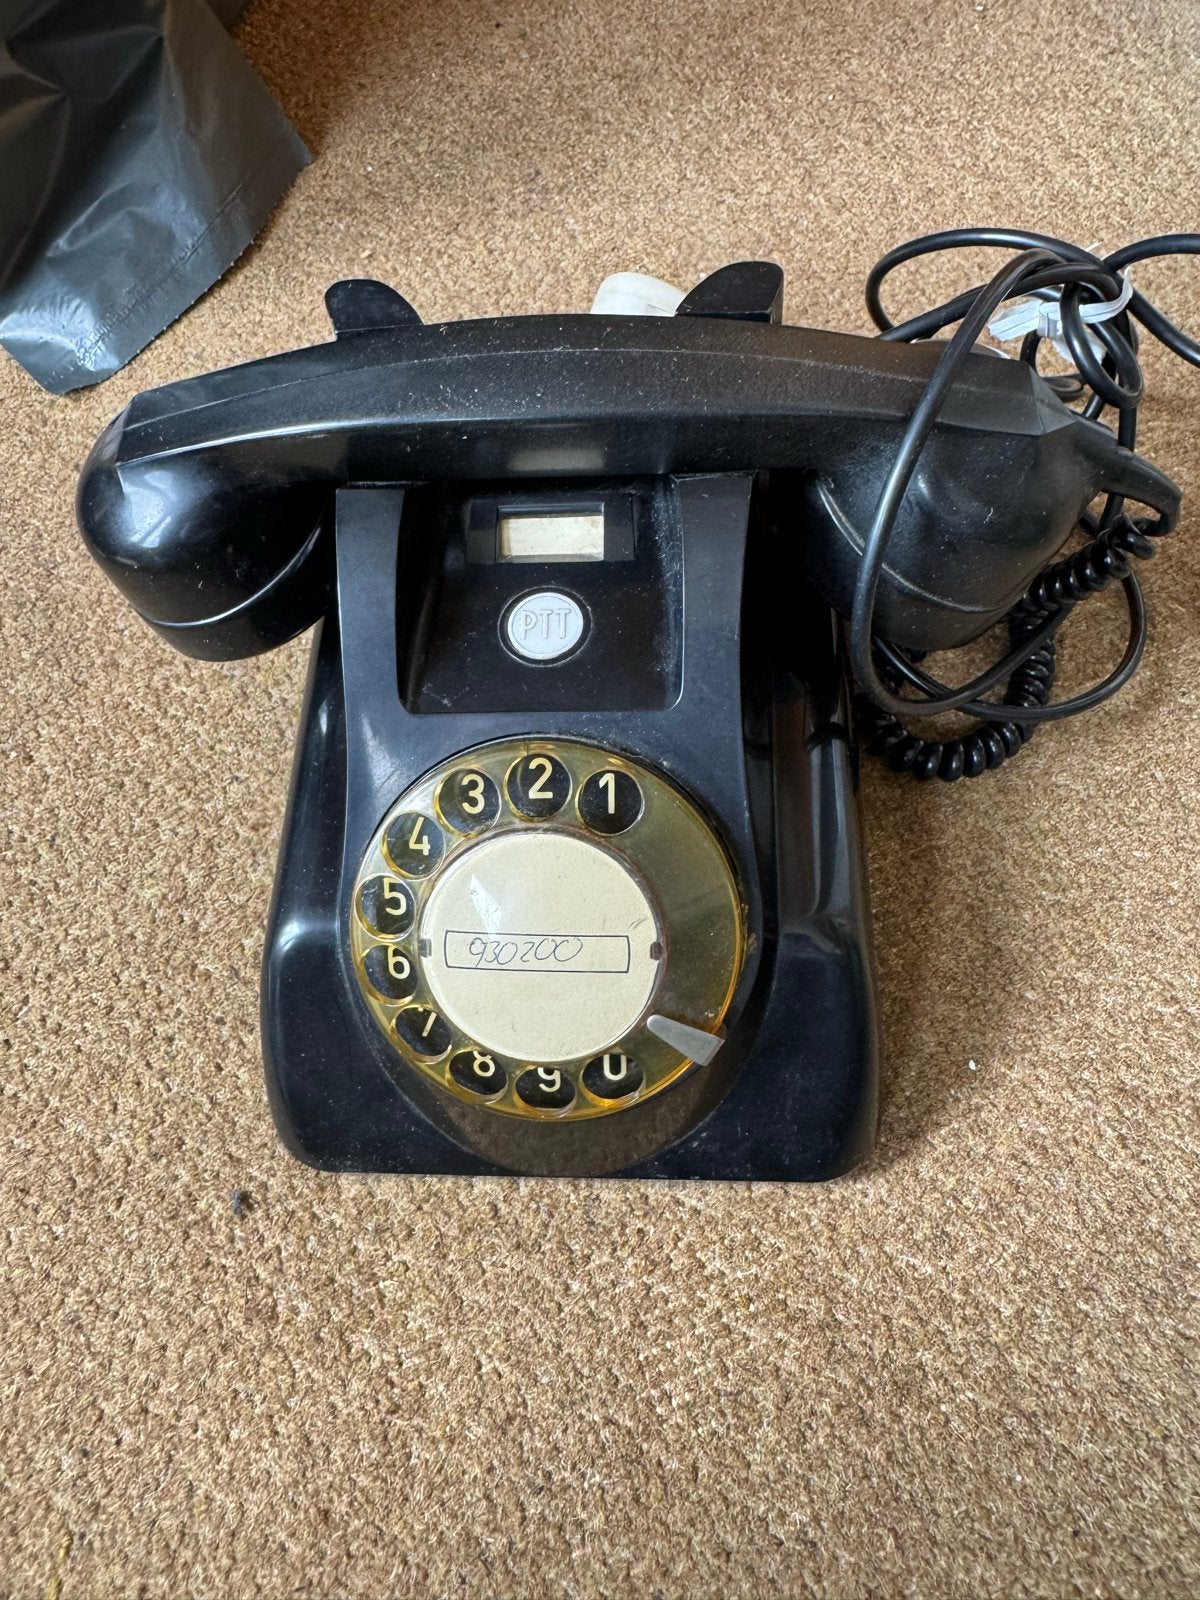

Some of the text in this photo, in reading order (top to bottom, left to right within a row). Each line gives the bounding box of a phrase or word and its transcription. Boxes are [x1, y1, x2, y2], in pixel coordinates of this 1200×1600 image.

[520, 607, 571, 640] PTT
[461, 773, 485, 814] 3
[528, 757, 554, 799] 2
[598, 773, 616, 814] 1
[408, 816, 431, 856] 4
[383, 877, 407, 916] 5
[387, 945, 411, 979] 6
[472, 1051, 496, 1078] 8
[537, 1067, 561, 1093] 9
[602, 1054, 627, 1081] 0
